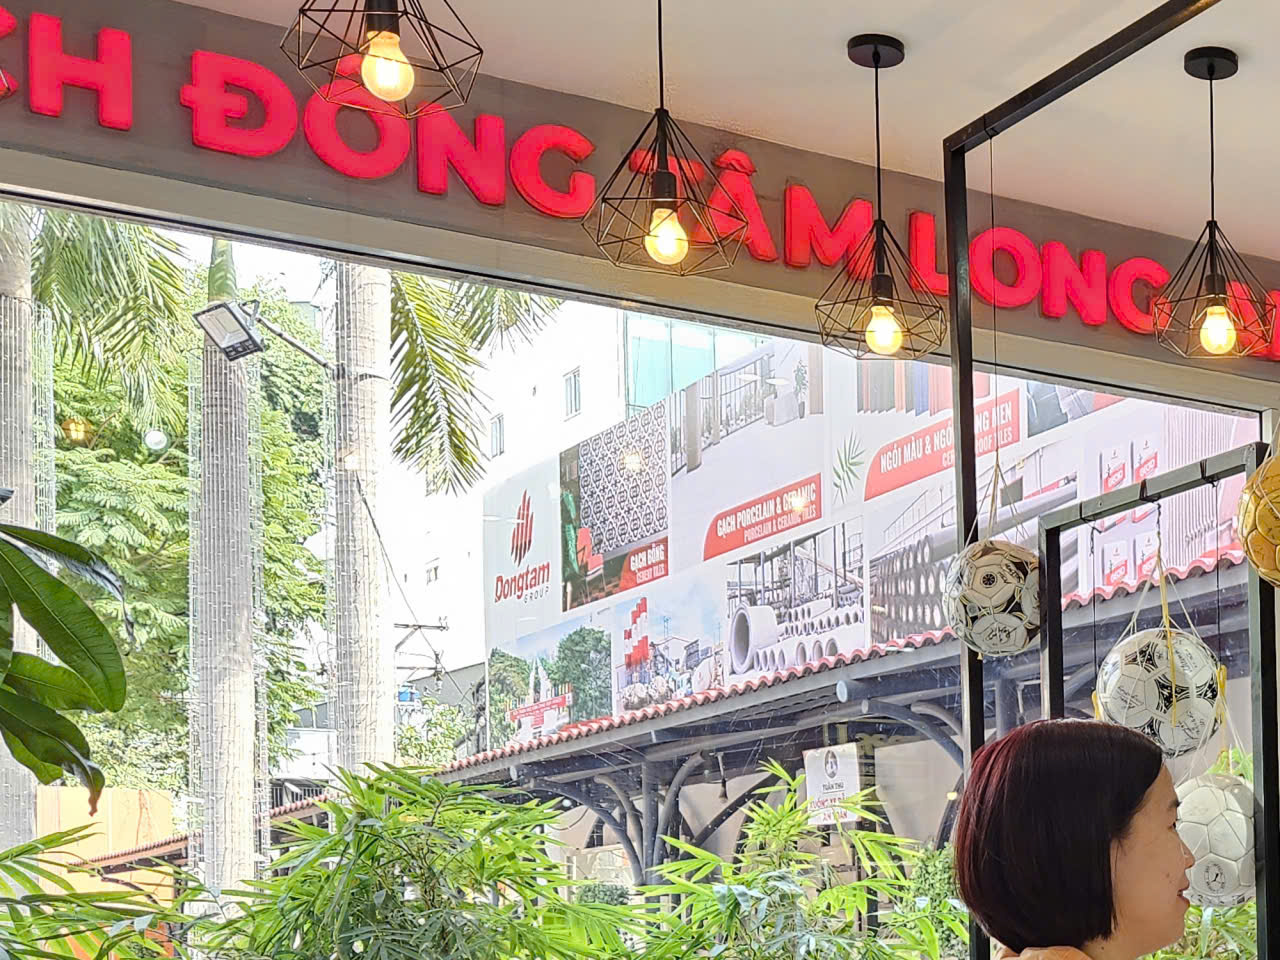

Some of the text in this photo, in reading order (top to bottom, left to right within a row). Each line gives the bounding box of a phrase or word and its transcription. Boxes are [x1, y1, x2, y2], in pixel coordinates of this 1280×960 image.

[0, 5, 132, 131] H
[910, 210, 1172, 335] LONG
[904, 432, 924, 465] MÀU
[925, 436, 931, 454] &
[716, 518, 735, 539] GẠCH
[737, 508, 775, 529] PORCELAIN
[776, 496, 782, 514] &
[744, 523, 772, 543] PORCELAIN
[494, 561, 551, 604] Dongtam
[525, 585, 551, 604] GROUP
